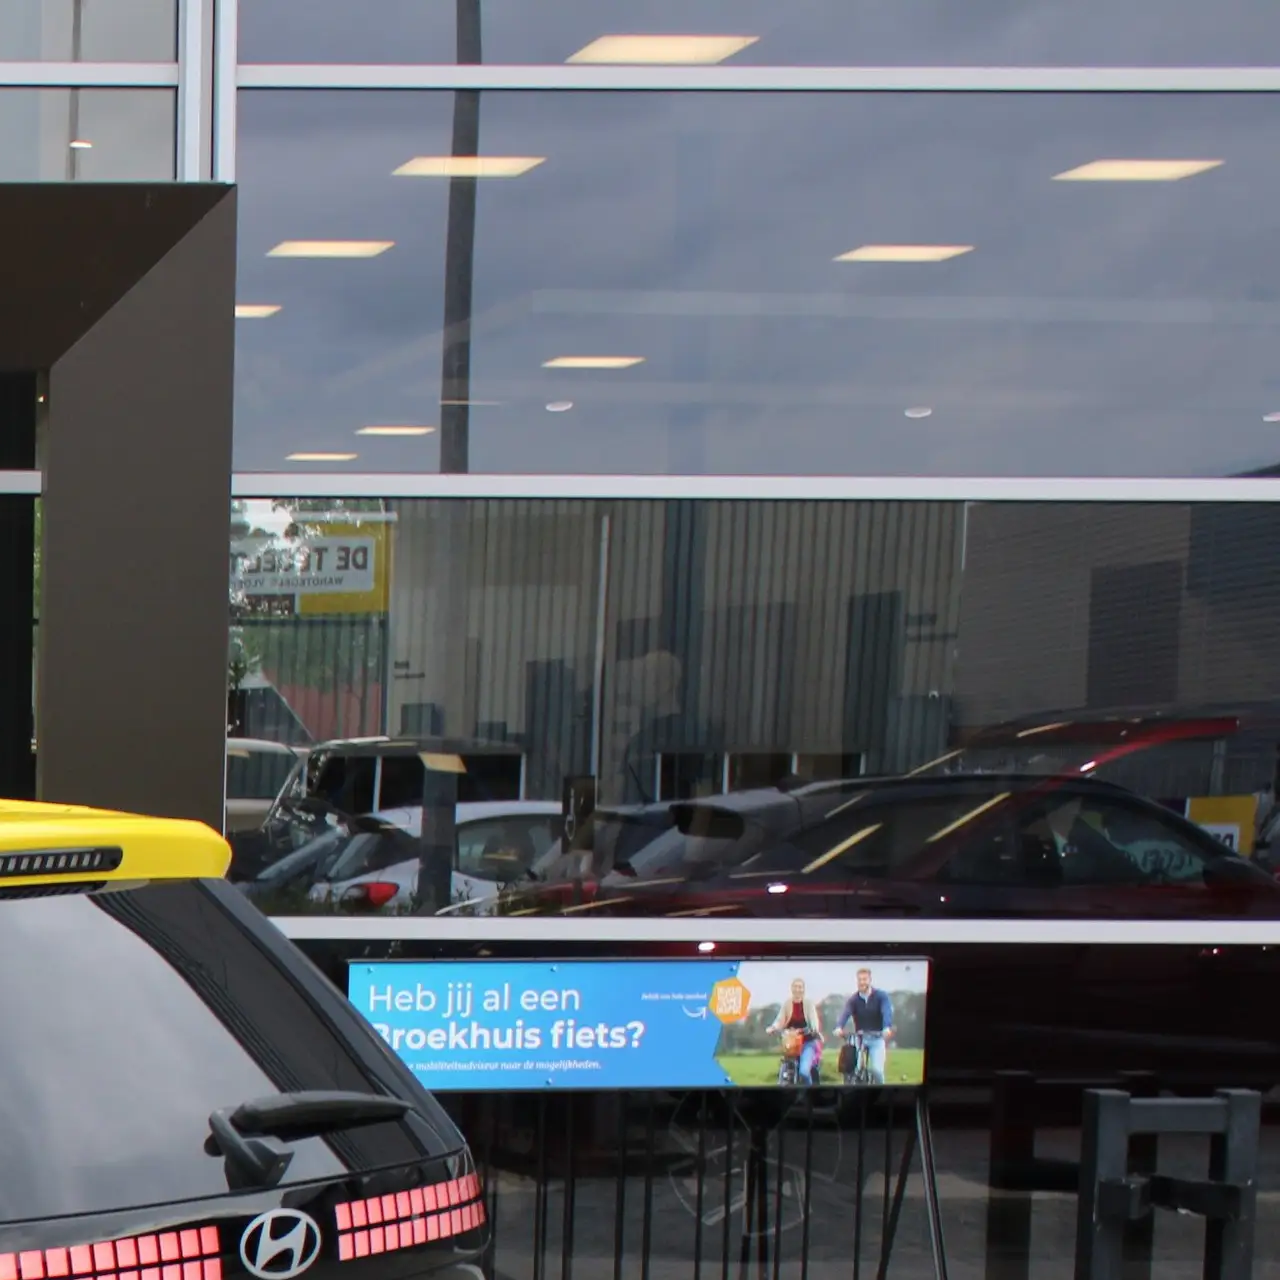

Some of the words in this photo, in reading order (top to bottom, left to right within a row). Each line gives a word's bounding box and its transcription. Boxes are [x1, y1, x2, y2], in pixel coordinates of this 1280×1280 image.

[369, 984, 437, 1012] Heb
[441, 983, 474, 1018] jij
[482, 983, 510, 1012] al
[520, 989, 580, 1011] een
[551, 1020, 645, 1049] fiets?
